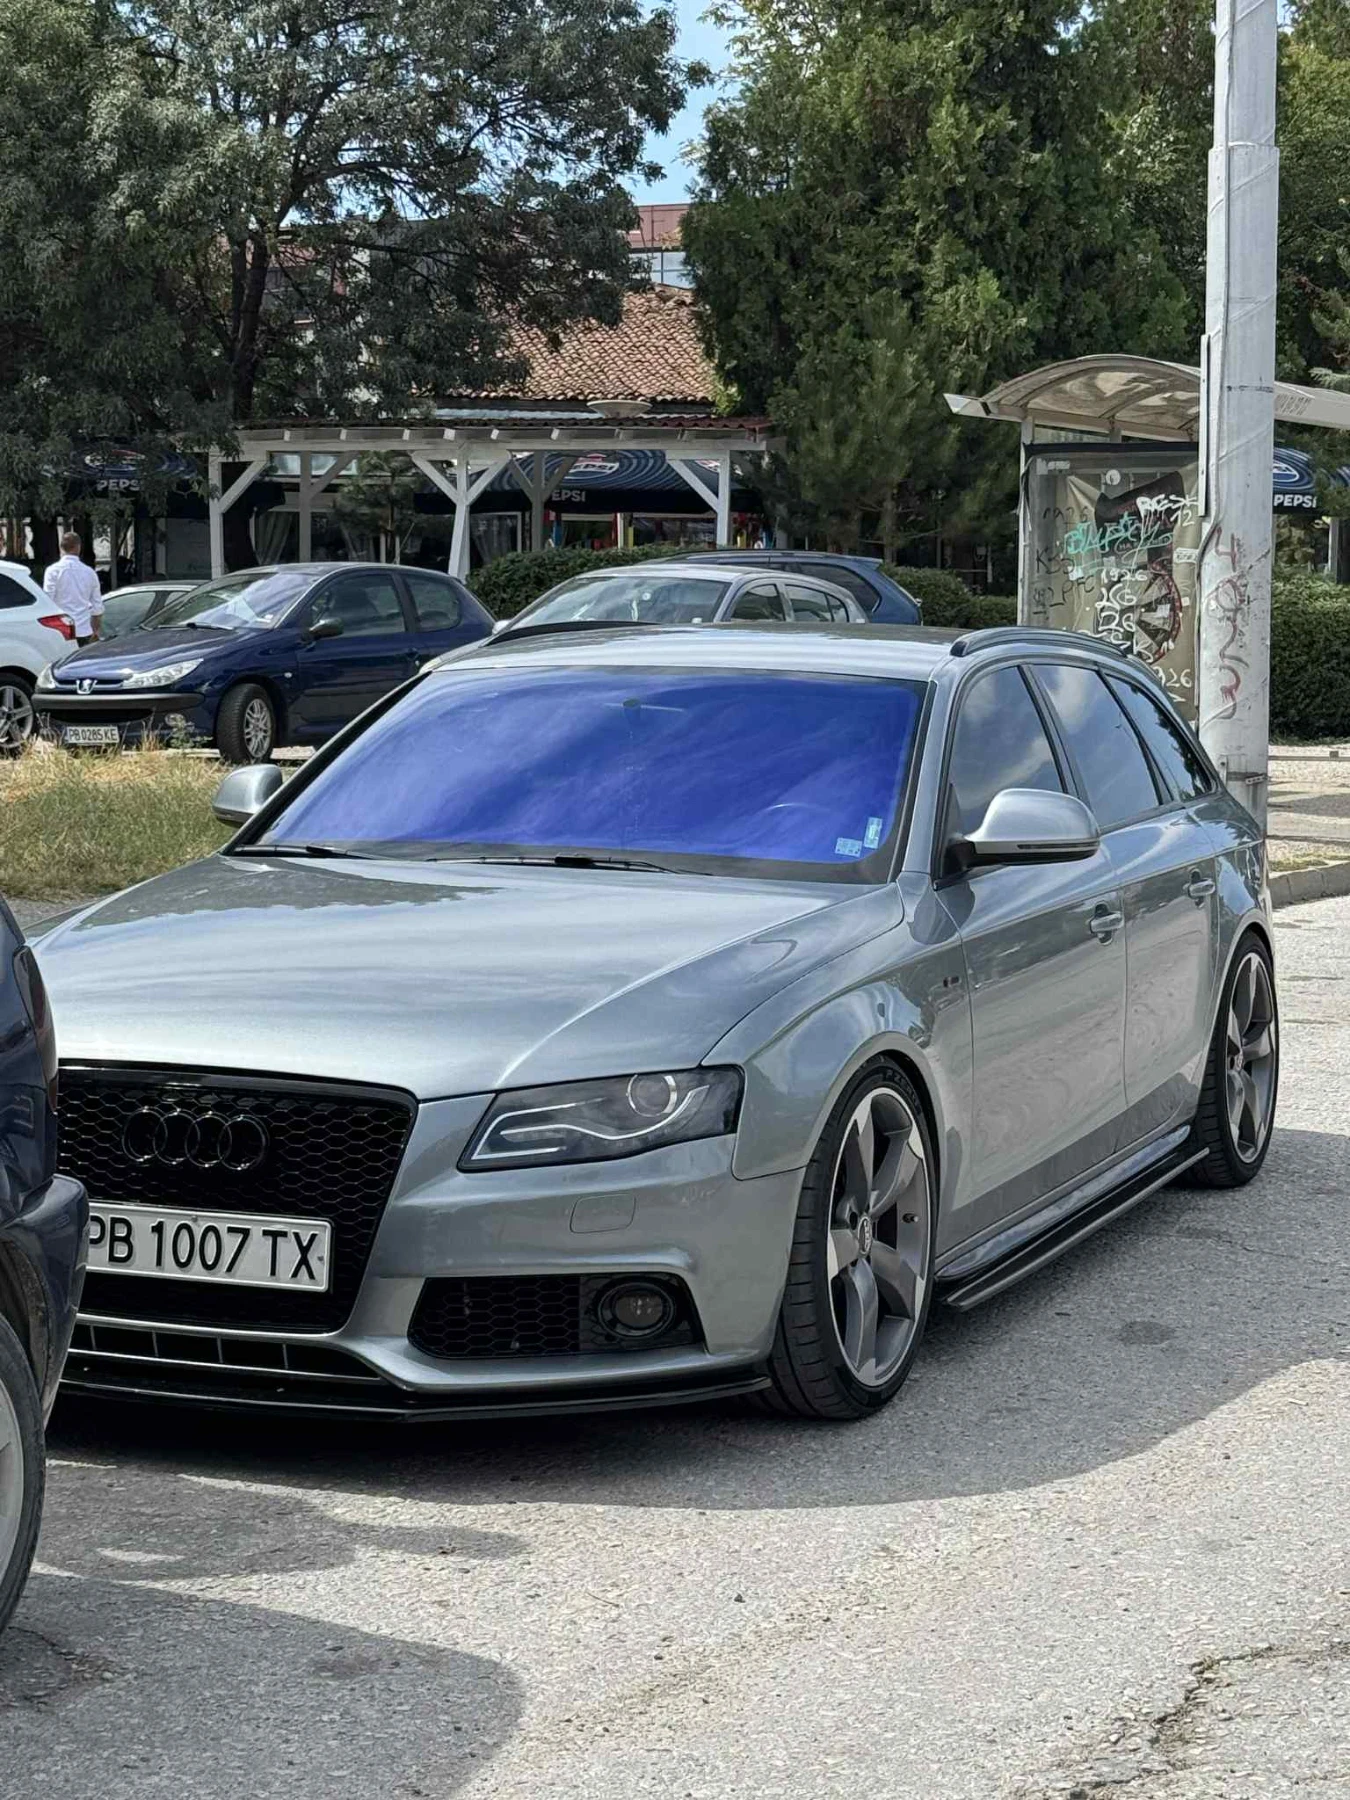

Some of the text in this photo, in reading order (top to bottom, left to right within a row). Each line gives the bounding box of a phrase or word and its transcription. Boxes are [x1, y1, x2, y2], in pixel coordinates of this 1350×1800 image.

[97, 479, 141, 492] PEPS
[551, 490, 586, 502] EPSI
[151, 1220, 251, 1273] 1007
[262, 1229, 319, 1280] TX
